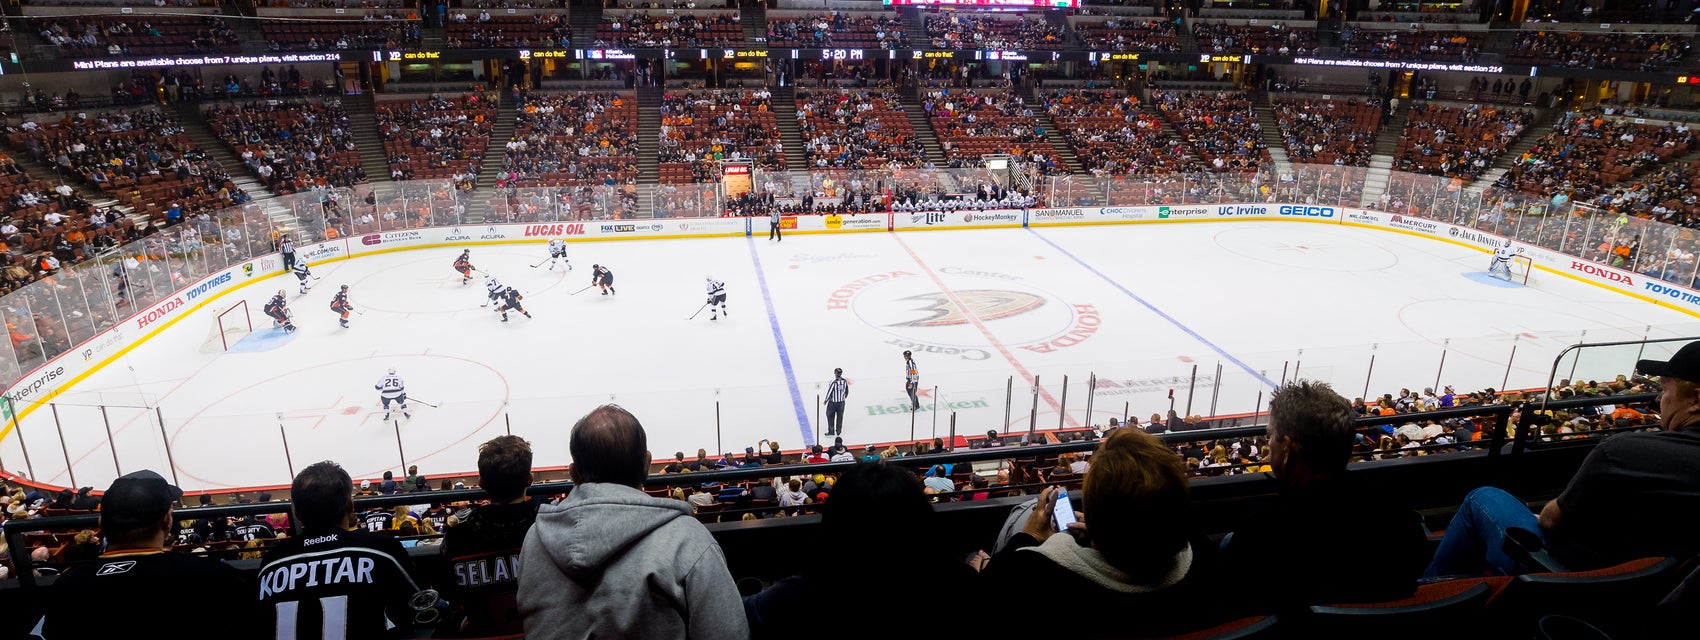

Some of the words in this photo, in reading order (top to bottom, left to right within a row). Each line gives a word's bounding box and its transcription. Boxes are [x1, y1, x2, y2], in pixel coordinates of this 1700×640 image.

[823, 49, 846, 60] 5:20
[851, 49, 863, 60] PM
[74, 61, 93, 69] Mini
[94, 60, 119, 68] Plans
[136, 58, 175, 67] available
[175, 57, 203, 65] choose
[204, 56, 223, 64] from
[231, 55, 258, 64] unique
[282, 54, 298, 62] visit
[1406, 62, 1428, 70] unique
[1163, 207, 1208, 217] enterprise
[1218, 206, 1233, 215] UC
[1236, 206, 1267, 215] Irvine
[1279, 206, 1334, 218] GEICO
[926, 213, 945, 225] Lite
[973, 213, 1018, 222] HockeyMonkey
[525, 224, 563, 237] LUCAS
[566, 223, 585, 235] OIL
[1403, 219, 1437, 230] MERCURY
[1570, 261, 1634, 286] HONDA
[186, 284, 208, 301] TOYO
[208, 271, 232, 289] TIRES
[827, 271, 920, 311] HONDA
[1645, 282, 1680, 298] TOYO
[137, 296, 185, 329] HONDA
[1018, 303, 1103, 354] HONDA
[82, 348, 92, 361] yp
[883, 338, 992, 361] Center
[384, 378, 399, 387] 26
[303, 534, 338, 547] Reebok
[259, 556, 375, 601] KOPITAR
[275, 594, 348, 640] 11
